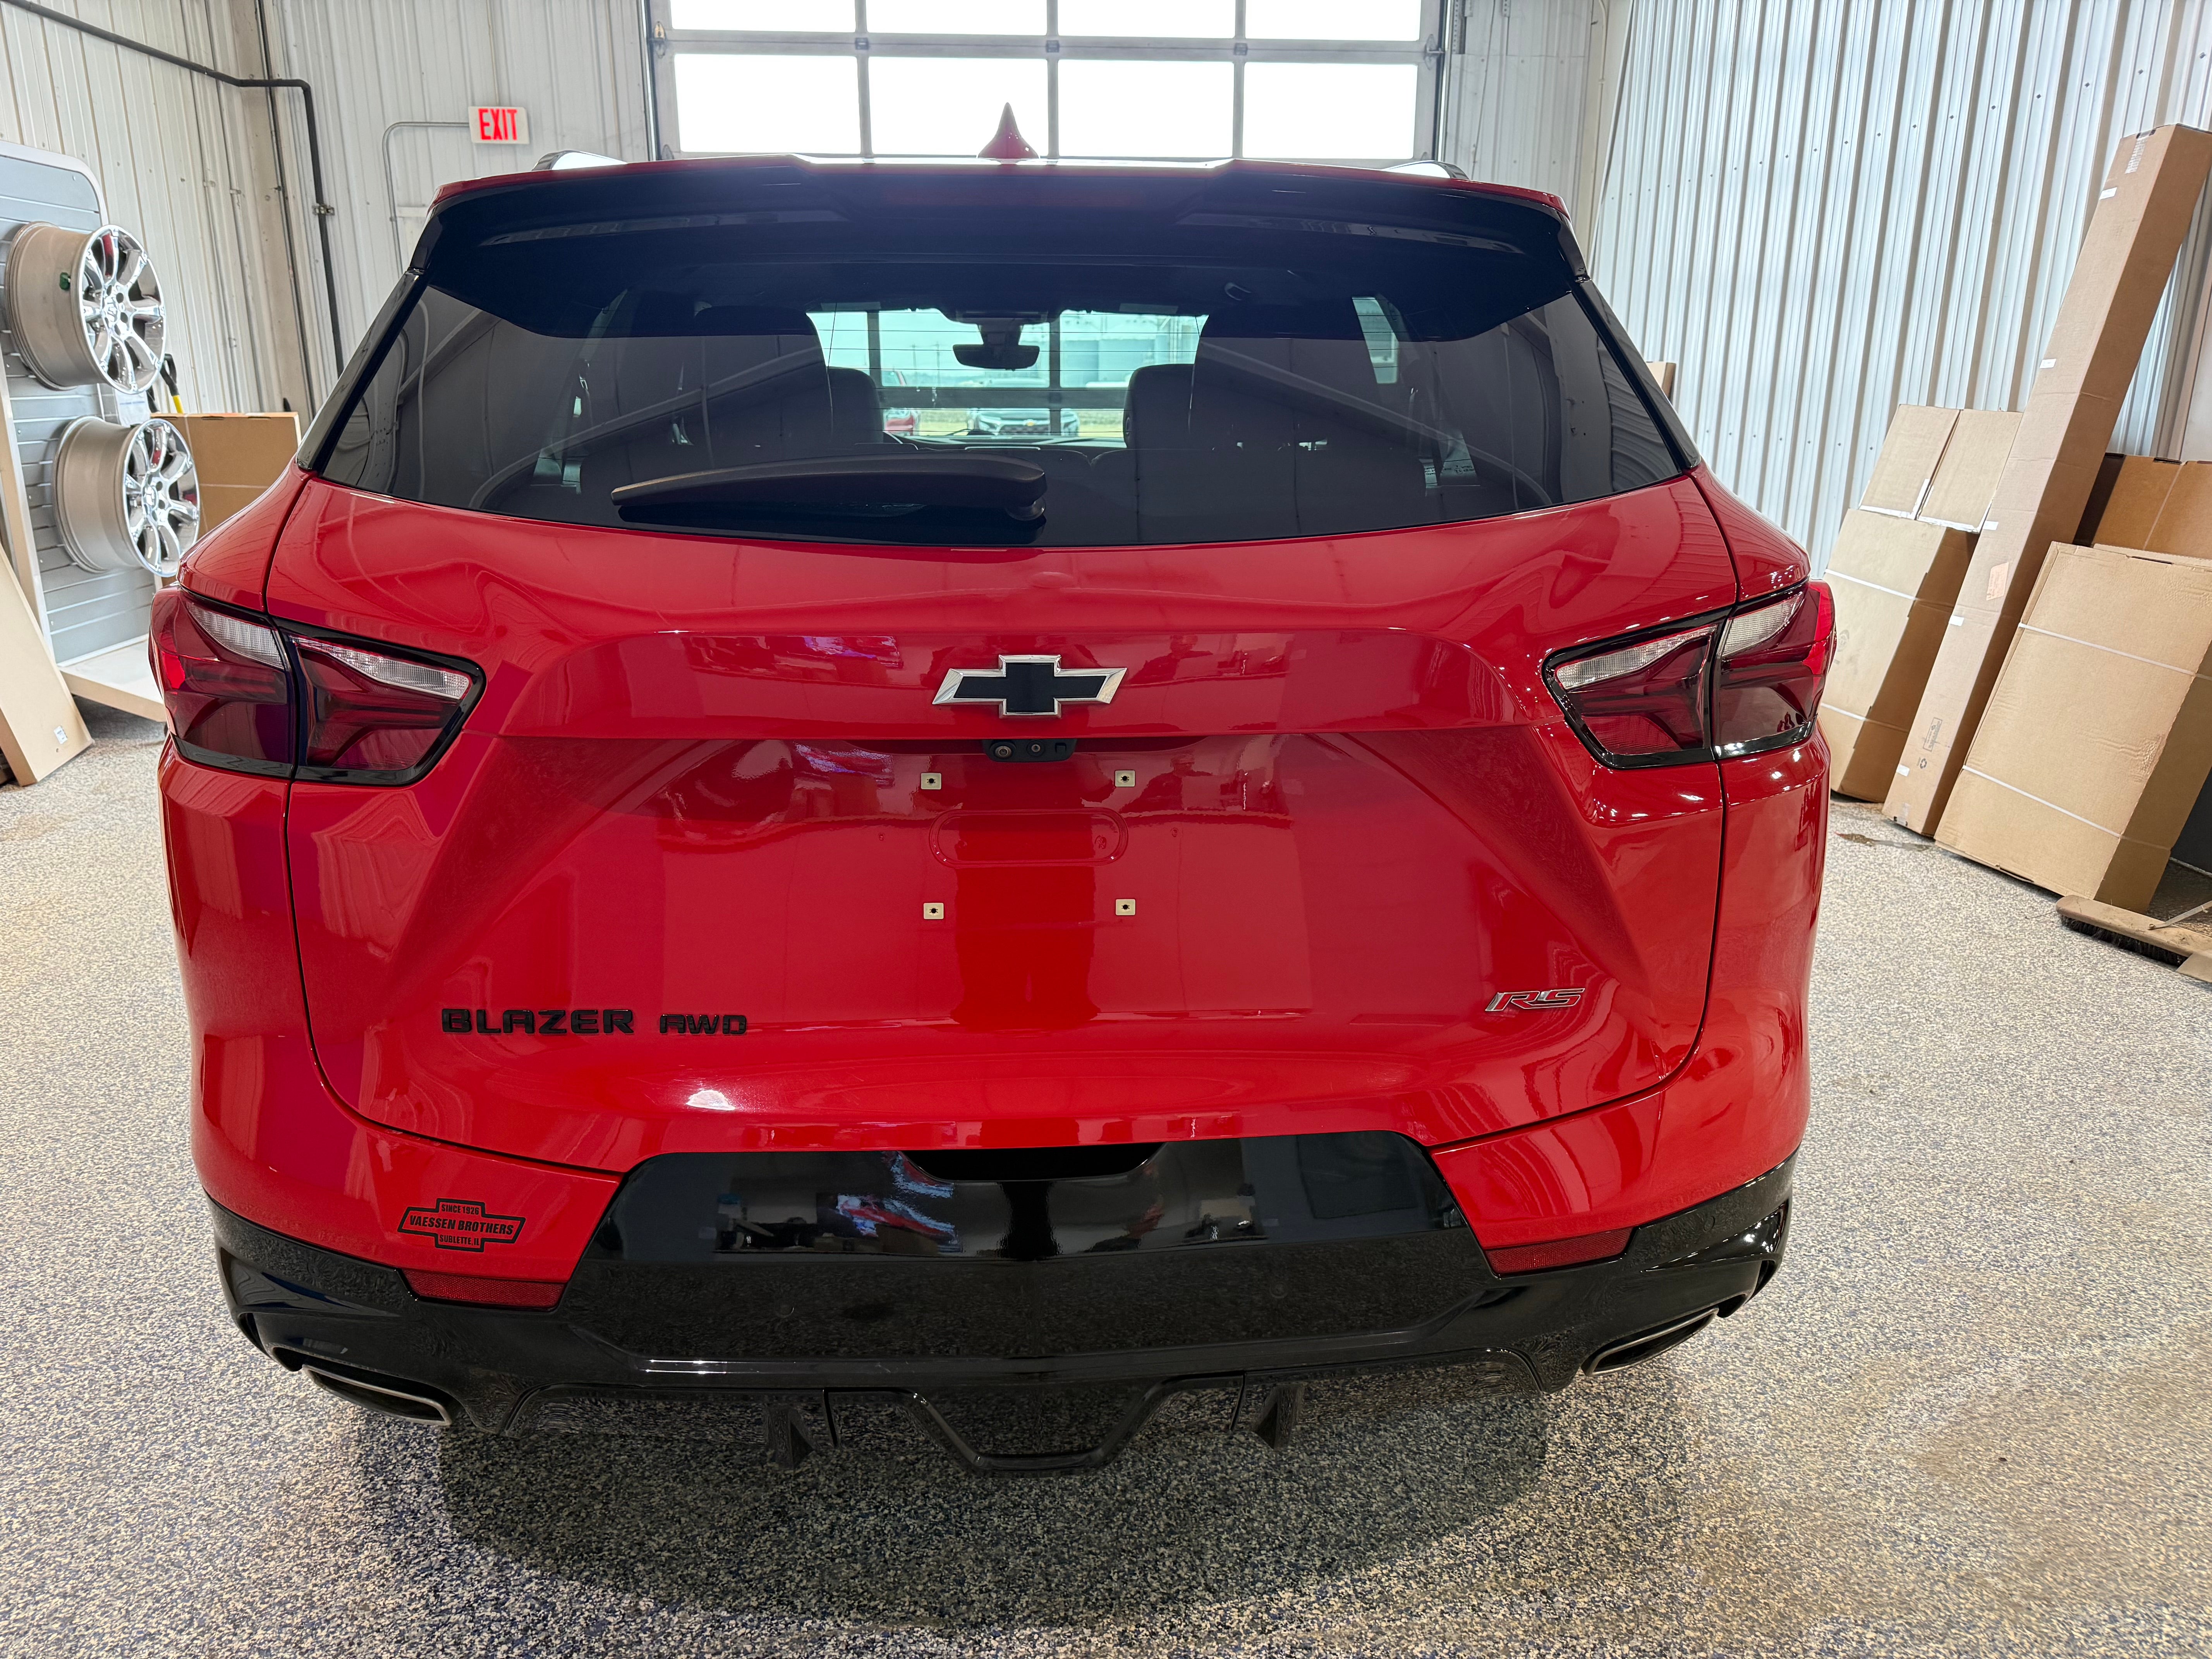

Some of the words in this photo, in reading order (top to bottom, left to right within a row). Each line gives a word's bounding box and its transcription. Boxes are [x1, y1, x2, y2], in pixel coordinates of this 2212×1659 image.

[478, 108, 517, 140] EXIT
[1485, 988, 1585, 1011] RS
[441, 1008, 634, 1034] BLAZER
[659, 1013, 747, 1035] AWD
[441, 1204, 461, 1213] SINCE
[462, 1206, 479, 1215] 1926
[410, 1215, 456, 1230] VAESSEN
[457, 1220, 514, 1235] BROTHERS
